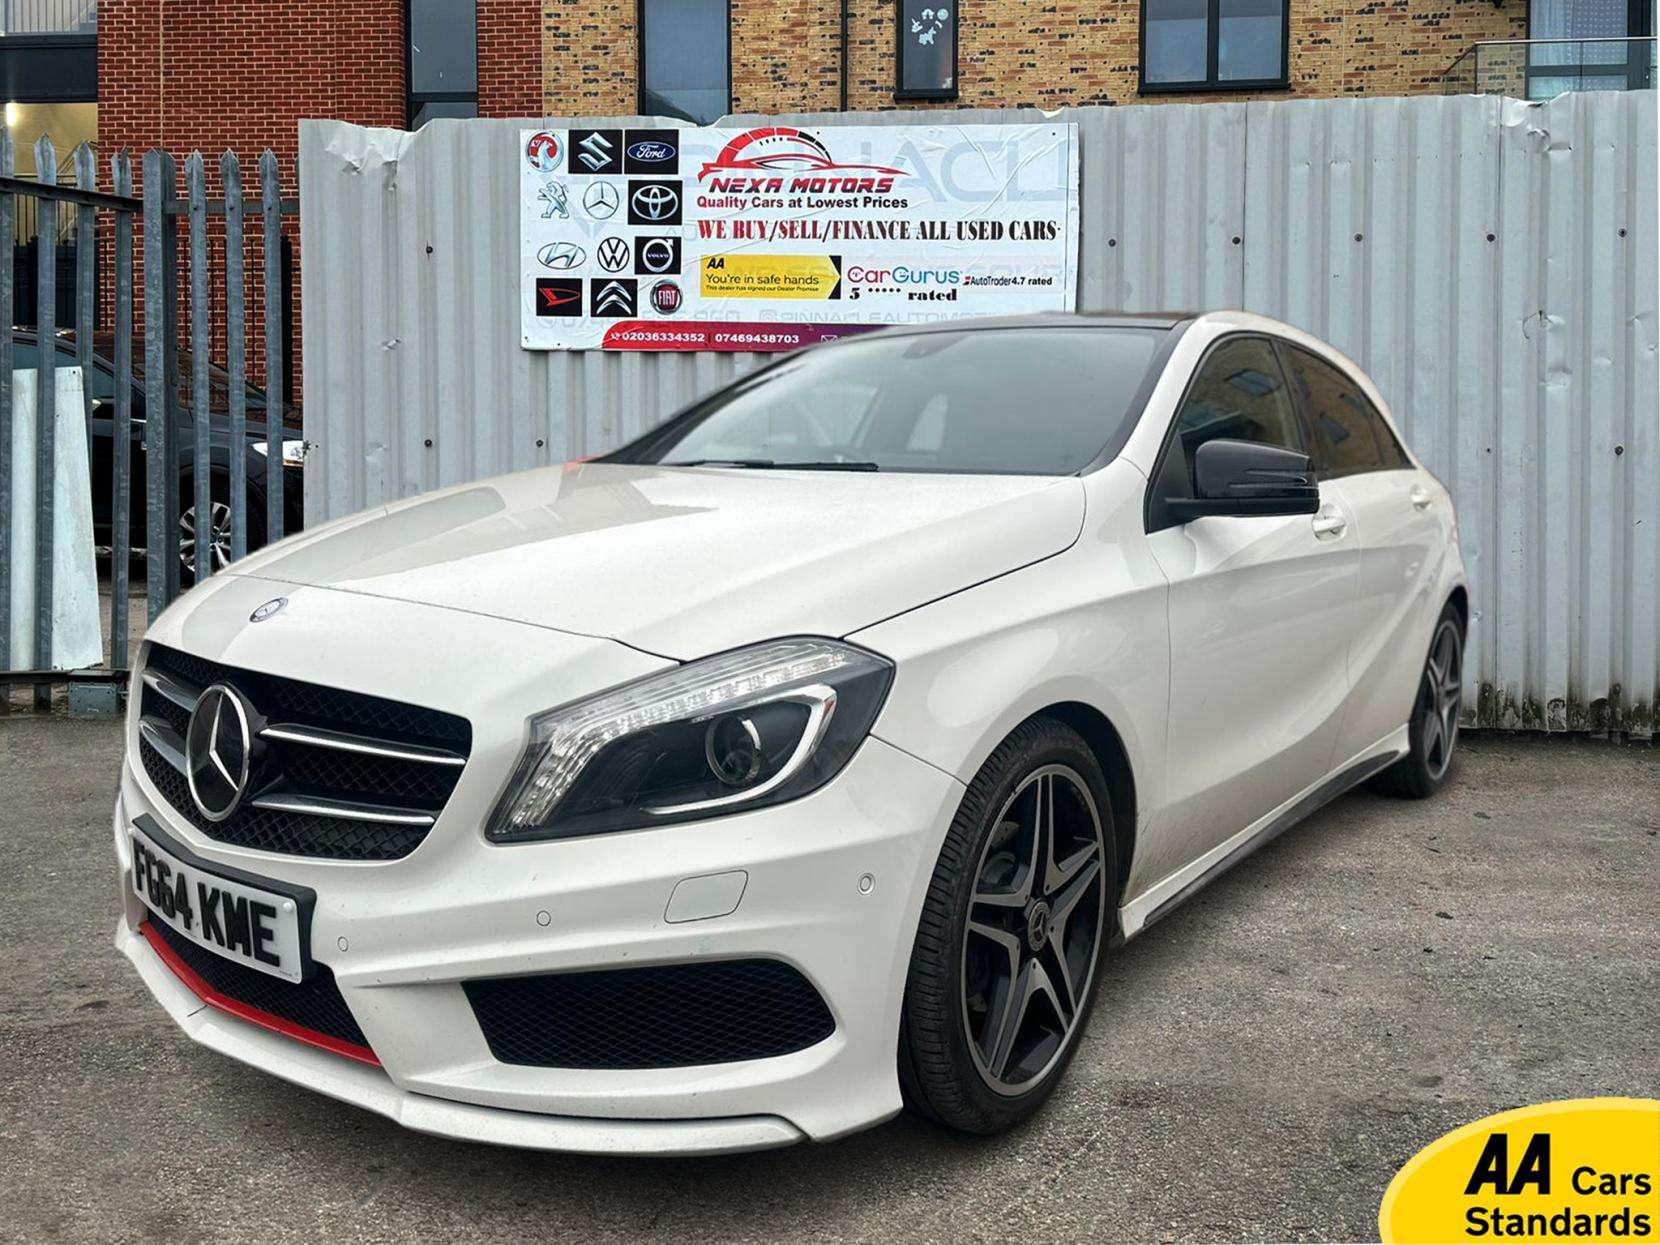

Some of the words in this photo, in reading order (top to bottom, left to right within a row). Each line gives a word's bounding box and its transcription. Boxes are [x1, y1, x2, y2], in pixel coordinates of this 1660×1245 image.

[636, 143, 666, 159] Ford
[708, 177, 784, 194] NEXA
[789, 177, 895, 194] MOTORS
[697, 196, 747, 211] Quality
[751, 196, 784, 209] Cars
[788, 197, 802, 209] at
[807, 197, 859, 209] Lowest
[863, 197, 909, 209] Prices
[698, 219, 727, 241] WE
[732, 219, 911, 243] BUY/SELL/FINANCE
[916, 220, 951, 241] ALL
[956, 220, 1004, 242] USED
[706, 257, 725, 269] AA
[706, 273, 741, 285] You're
[743, 273, 755, 285] in
[757, 273, 781, 285] safe
[783, 274, 820, 286] hands
[847, 266, 960, 285] CarGurus
[1027, 277, 1053, 285] rated
[658, 289, 677, 306] FIAT
[849, 288, 860, 300] 5
[908, 288, 958, 301] rated
[715, 333, 800, 344] 07469438703
[197, 882, 281, 968] KME
